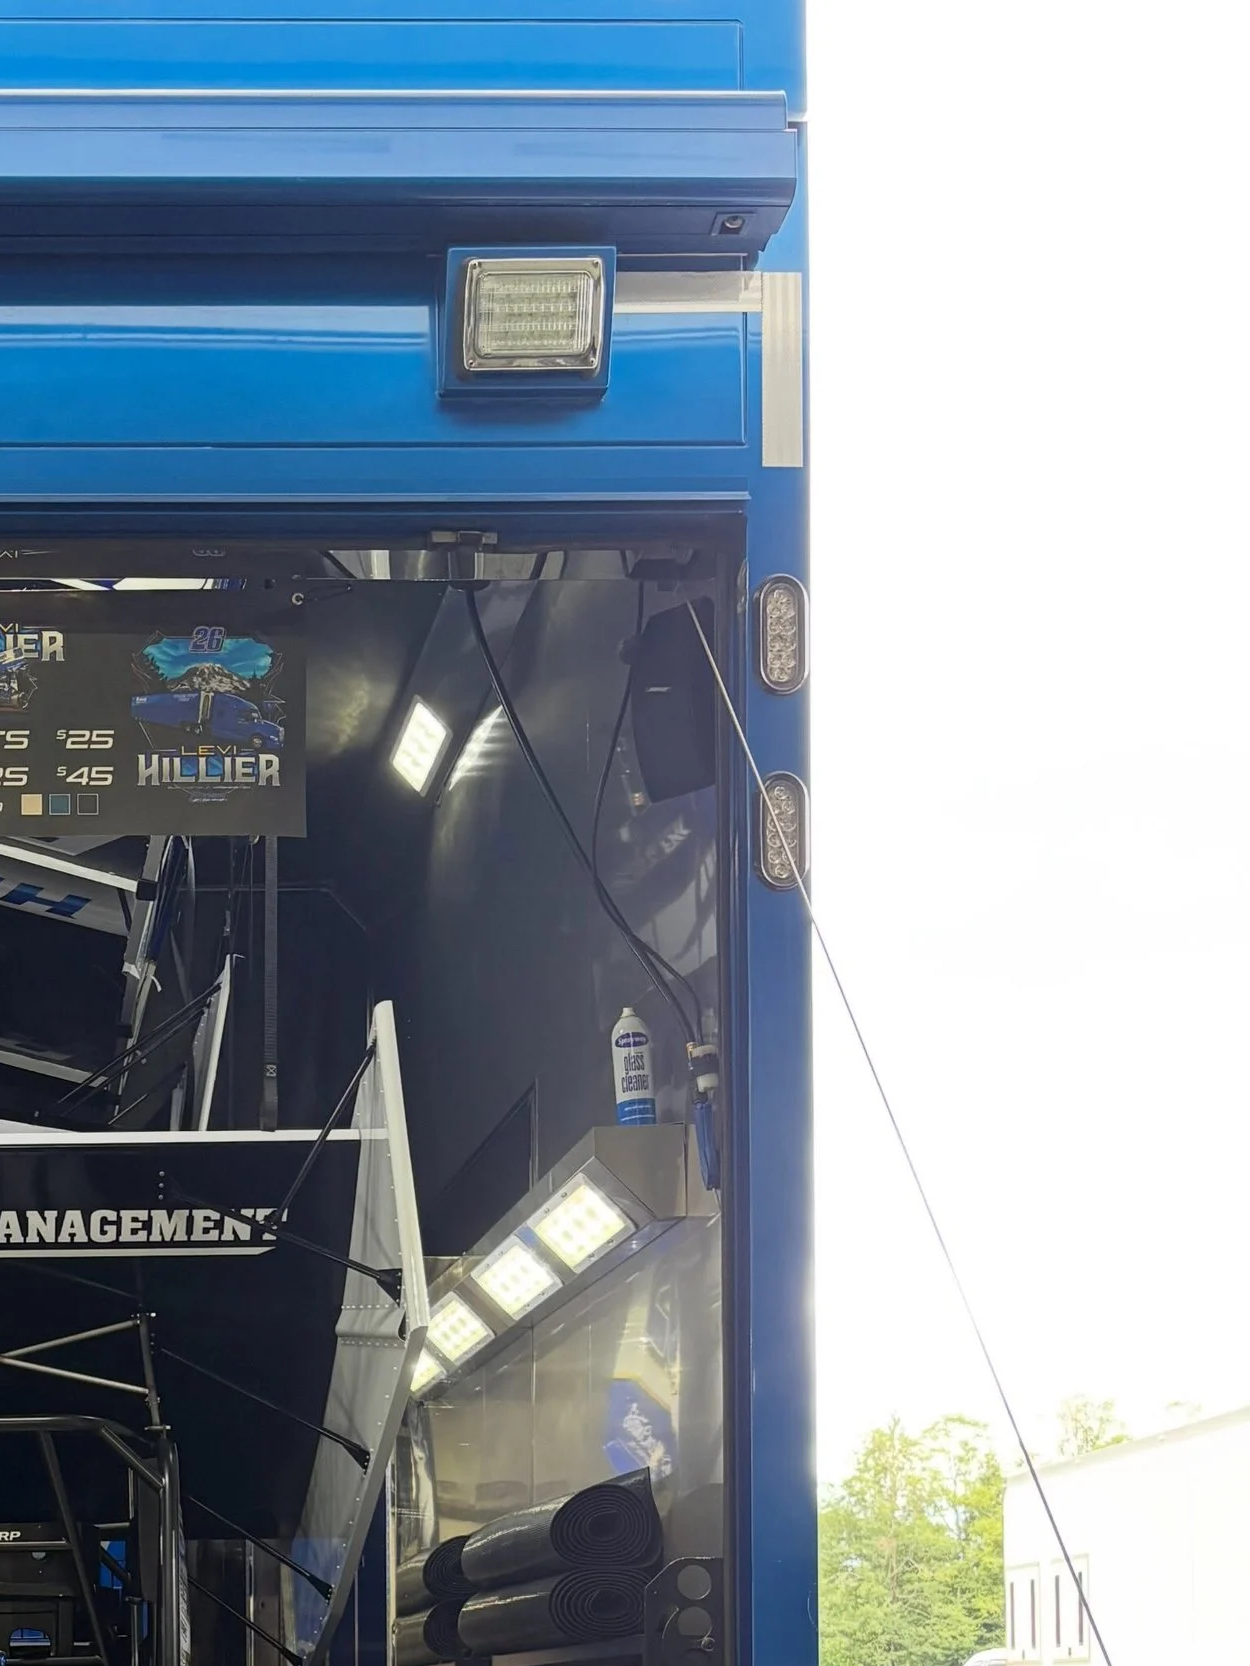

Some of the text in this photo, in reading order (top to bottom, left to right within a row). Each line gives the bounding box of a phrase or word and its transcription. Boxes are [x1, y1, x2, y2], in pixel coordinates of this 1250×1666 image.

[190, 626, 226, 654] 26
[56, 729, 115, 750] $25
[181, 745, 237, 756] LEVI
[56, 766, 114, 786] $45
[137, 753, 281, 787] HILLIER
[623, 1053, 645, 1074] glass
[621, 1074, 650, 1093] cleaner
